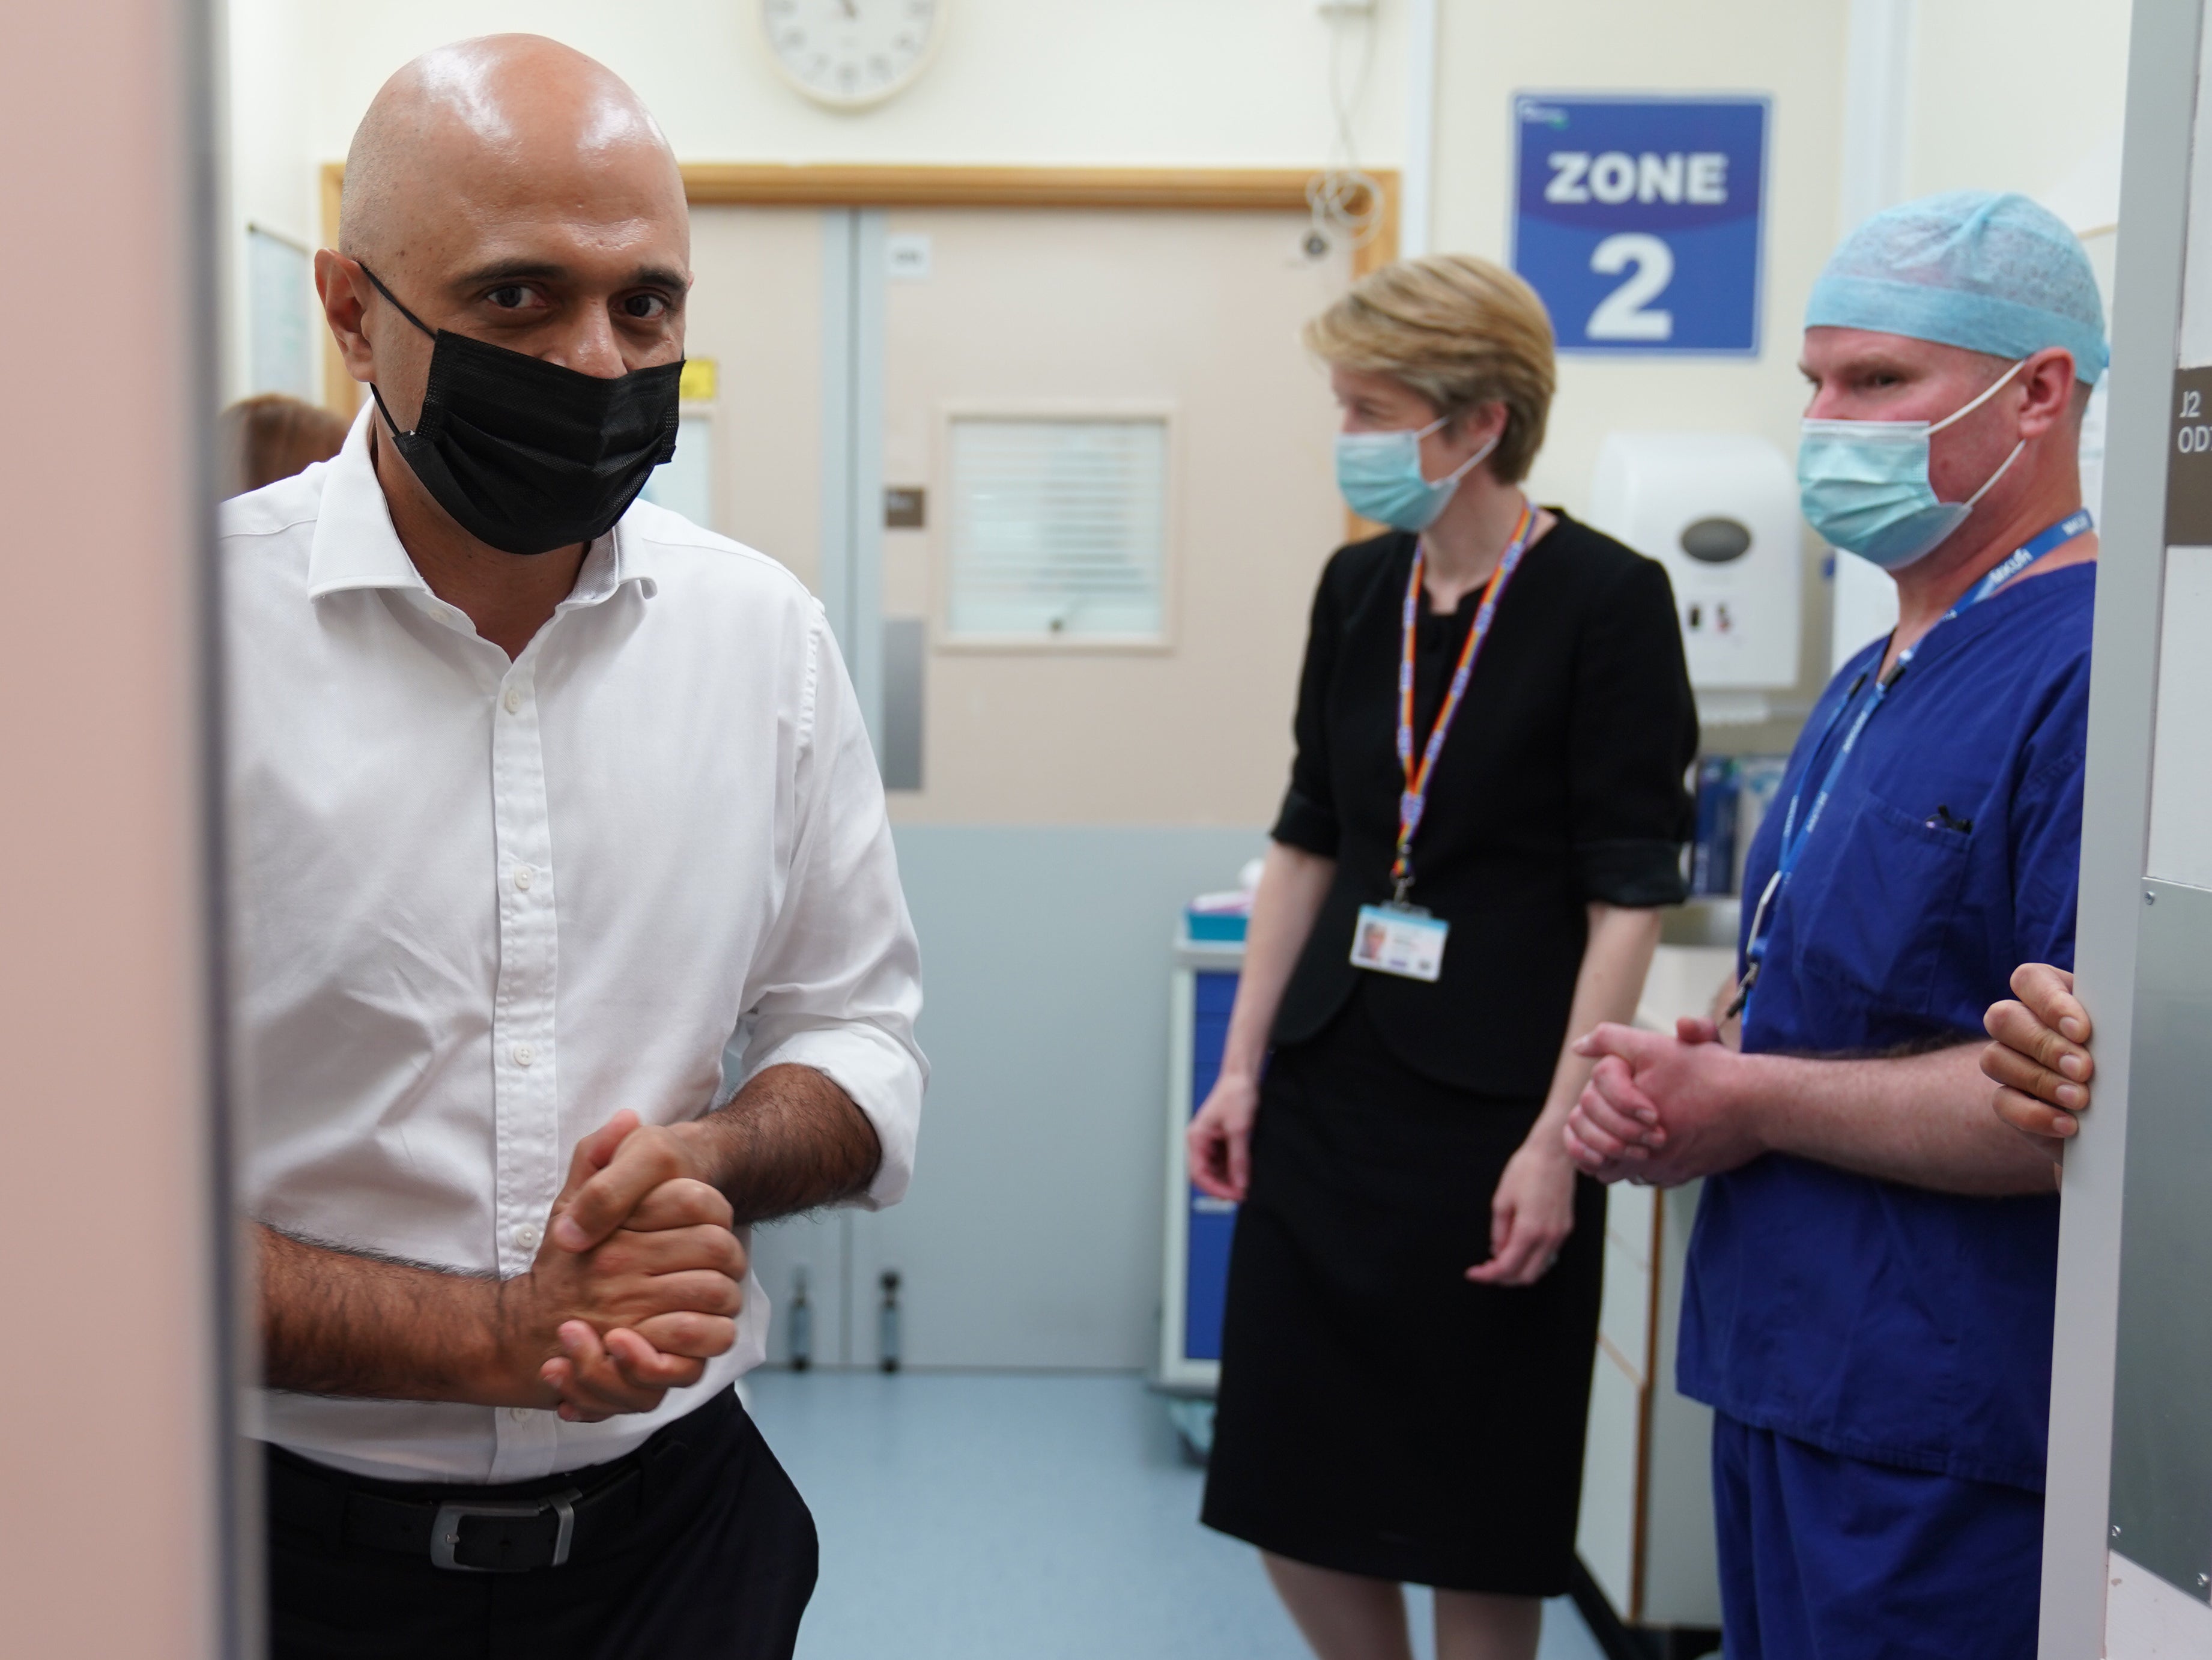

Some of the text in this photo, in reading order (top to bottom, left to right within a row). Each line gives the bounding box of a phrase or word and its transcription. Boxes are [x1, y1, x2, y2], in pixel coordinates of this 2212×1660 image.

[1545, 151, 1728, 204] ZONE
[1586, 232, 1674, 341] 2
[2178, 425, 2212, 453] OD
